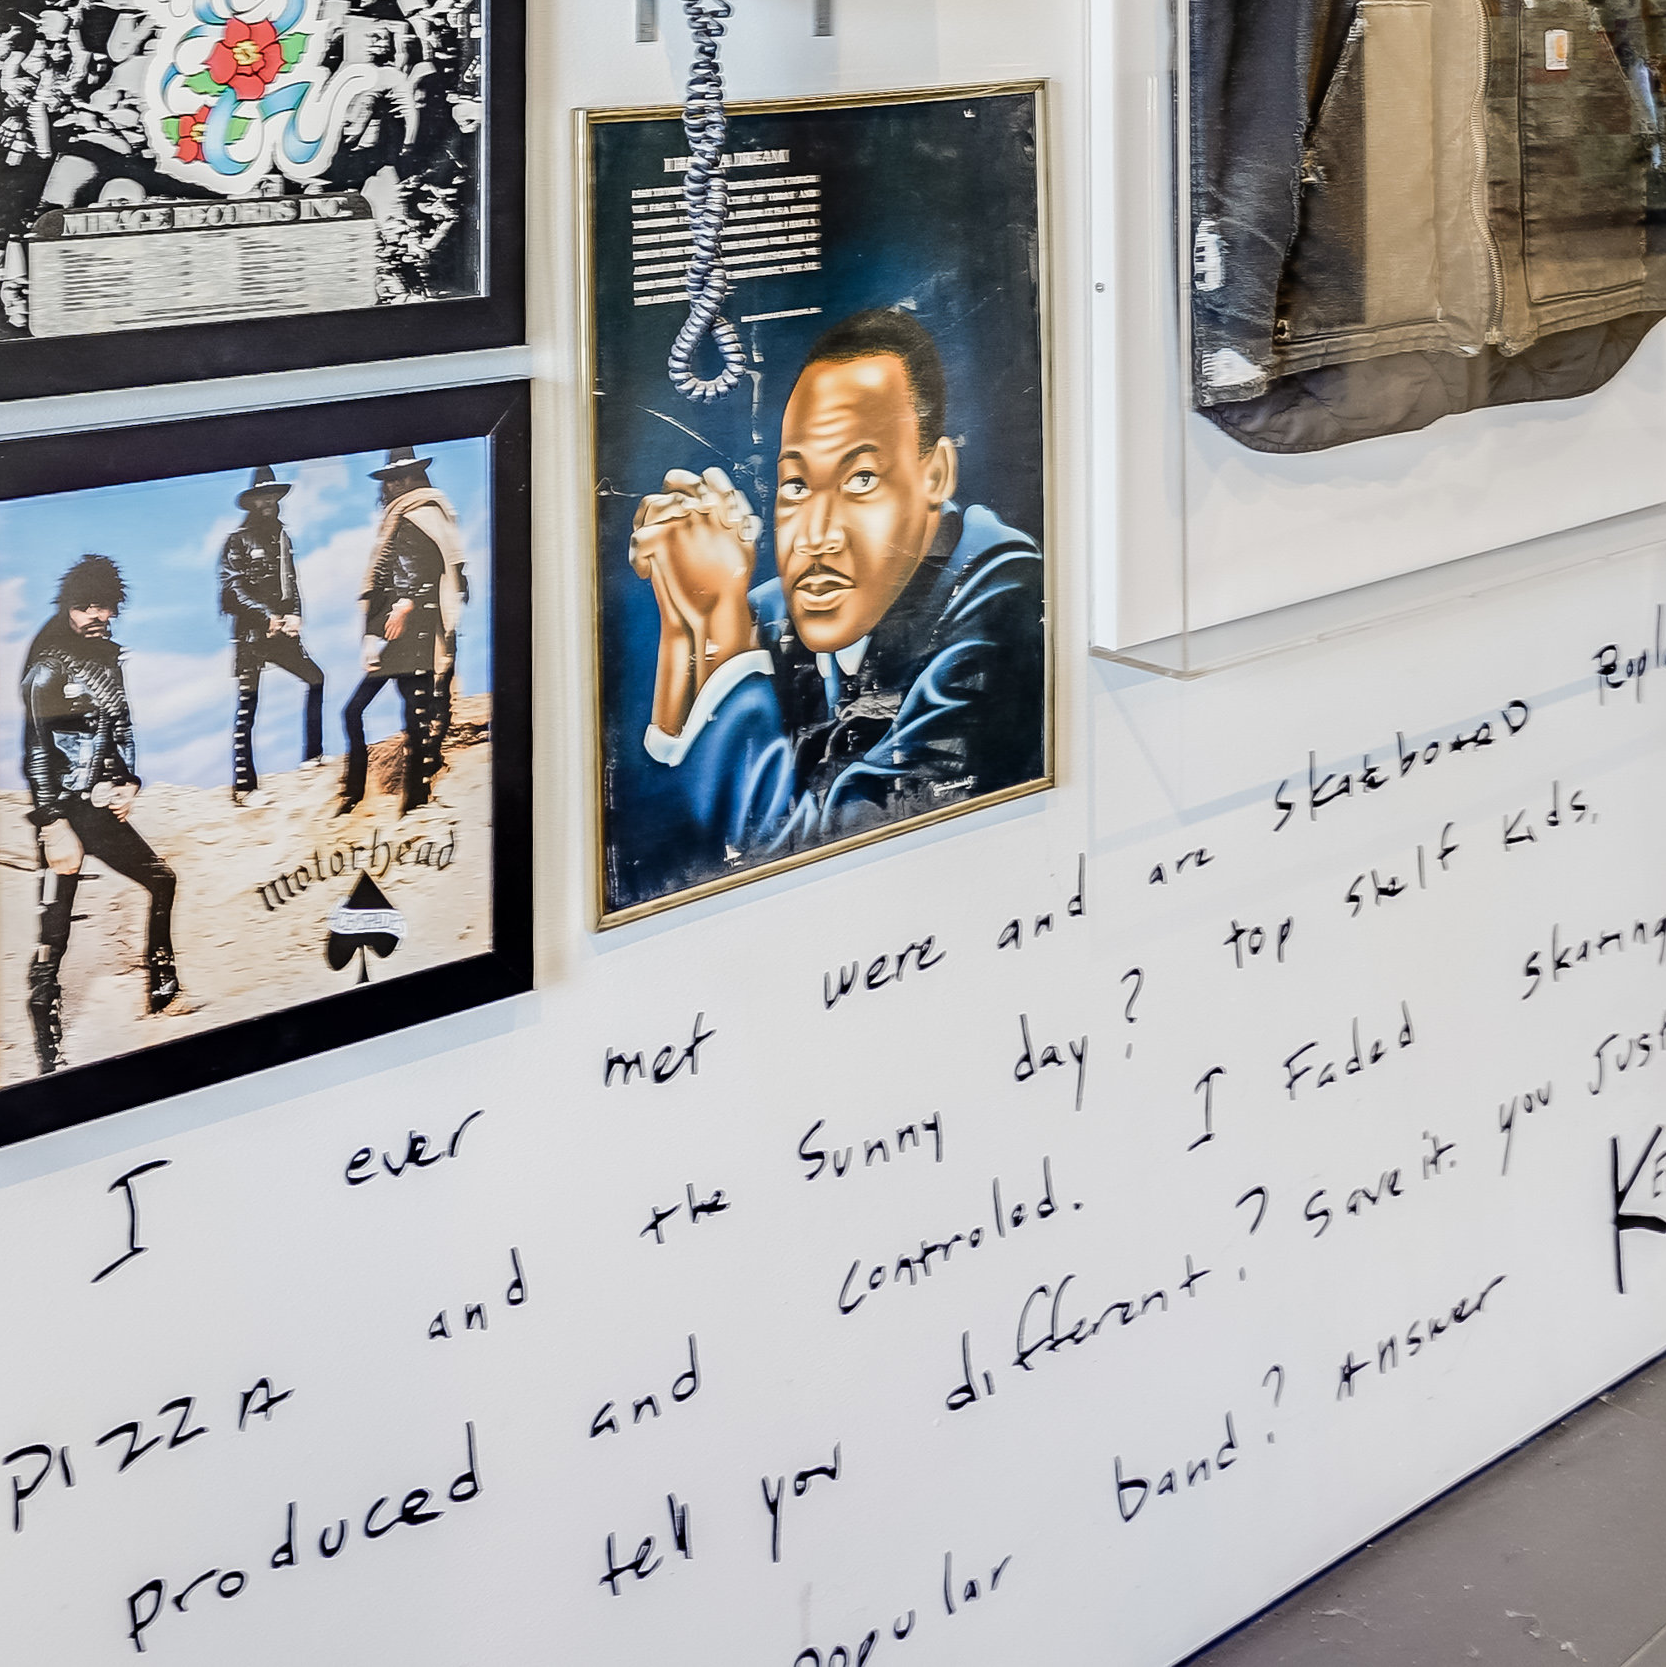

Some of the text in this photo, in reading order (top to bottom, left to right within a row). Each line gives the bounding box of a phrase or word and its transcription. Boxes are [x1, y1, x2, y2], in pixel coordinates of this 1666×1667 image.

[90, 1157, 172, 1284] I
[344, 1108, 486, 1187] ever
[602, 1011, 718, 1089] met
[823, 933, 949, 1011] were
[997, 852, 1087, 951] and
[1148, 846, 1216, 886] are
[428, 1245, 530, 1341] and
[639, 1181, 732, 1245] the
[1222, 915, 1294, 968] top
[127, 1419, 484, 1654] produced
[589, 1332, 702, 1439] and
[1186, 1064, 1228, 1154] I
[1282, 999, 1417, 1101] Faded
[598, 1491, 695, 1596] tell
[762, 1439, 844, 1565] you
[1497, 1080, 1552, 1176] you
